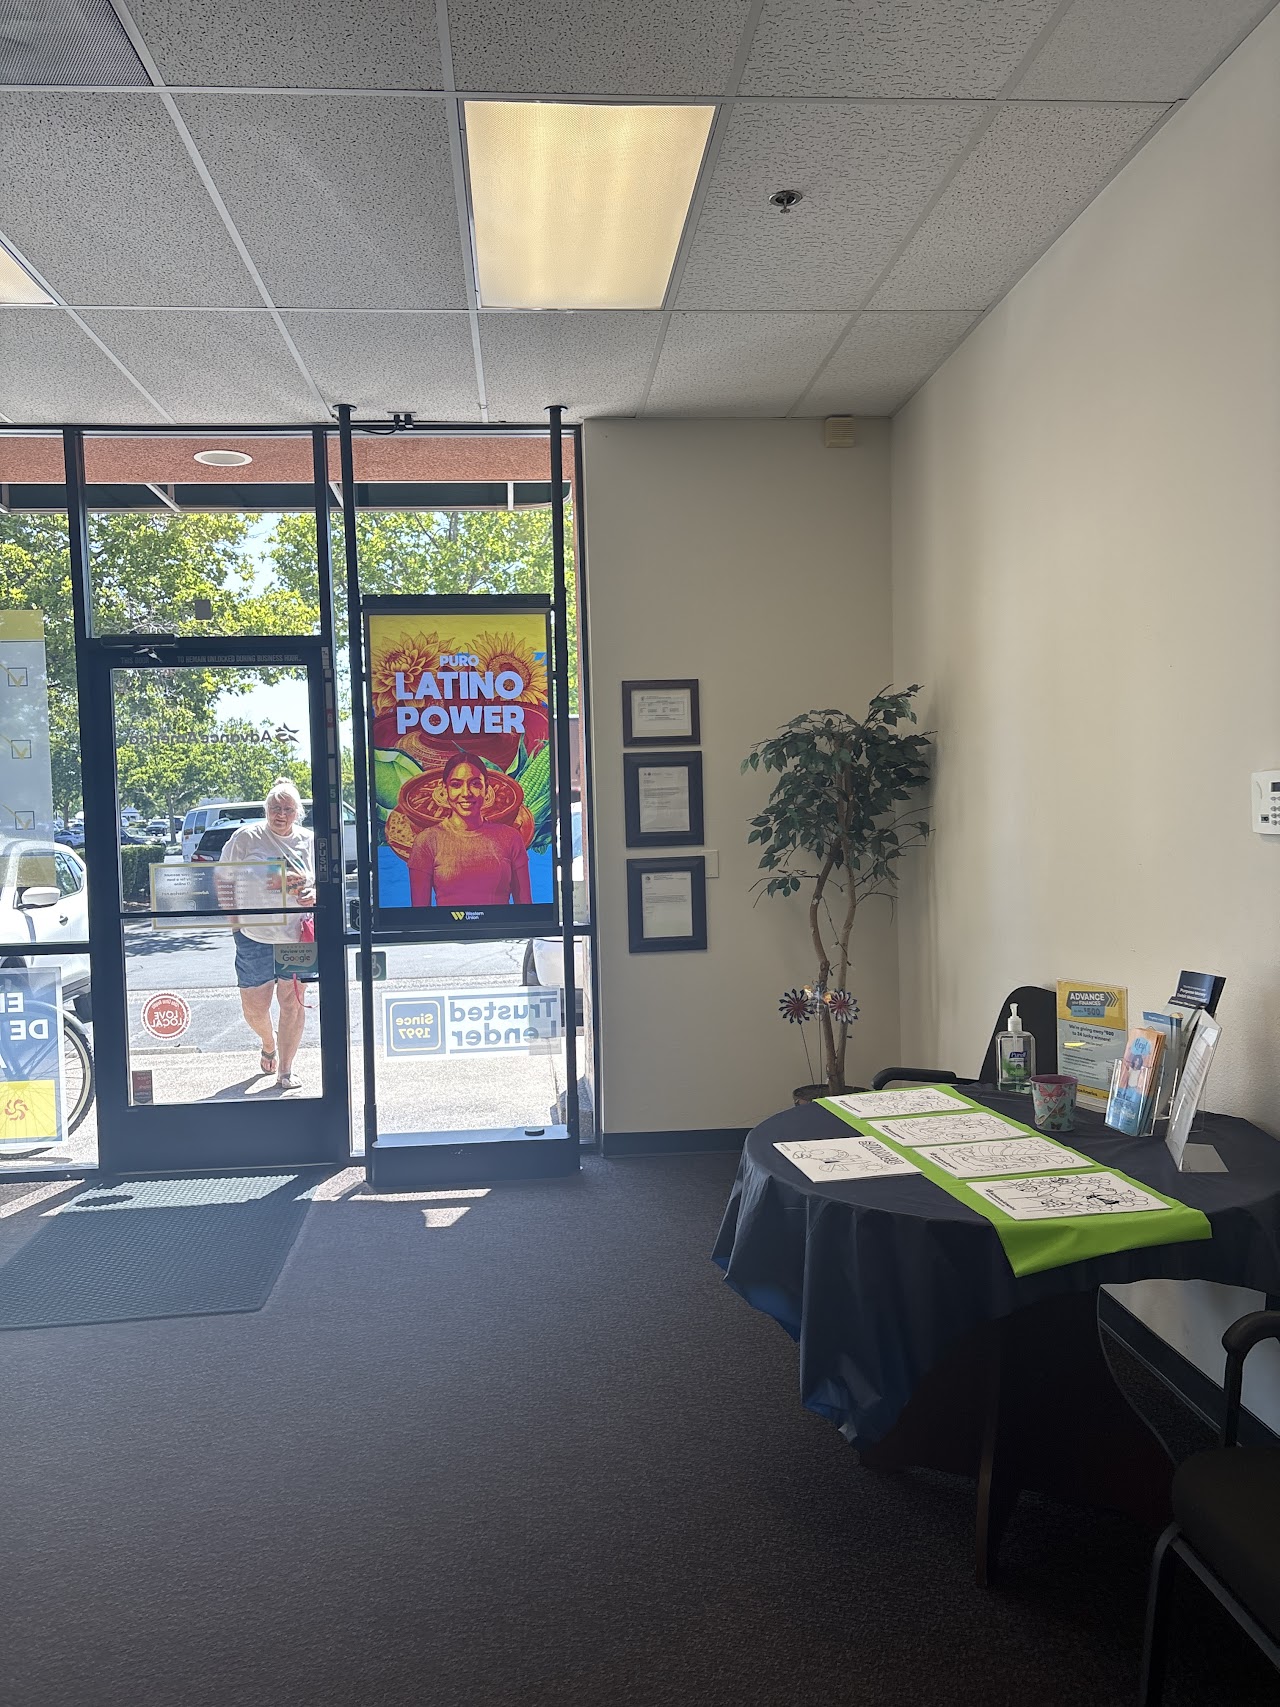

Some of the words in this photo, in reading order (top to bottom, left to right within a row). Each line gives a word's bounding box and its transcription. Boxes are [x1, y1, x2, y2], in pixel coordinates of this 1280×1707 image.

[440, 655, 480, 666] PURO
[395, 671, 524, 700] LATINO
[396, 705, 525, 735] POWER
[319, 842, 327, 872] PUSH
[282, 954, 311, 962] Google
[1070, 992, 1105, 1001] ADVANCE
[1084, 1008, 1100, 1016] $500
